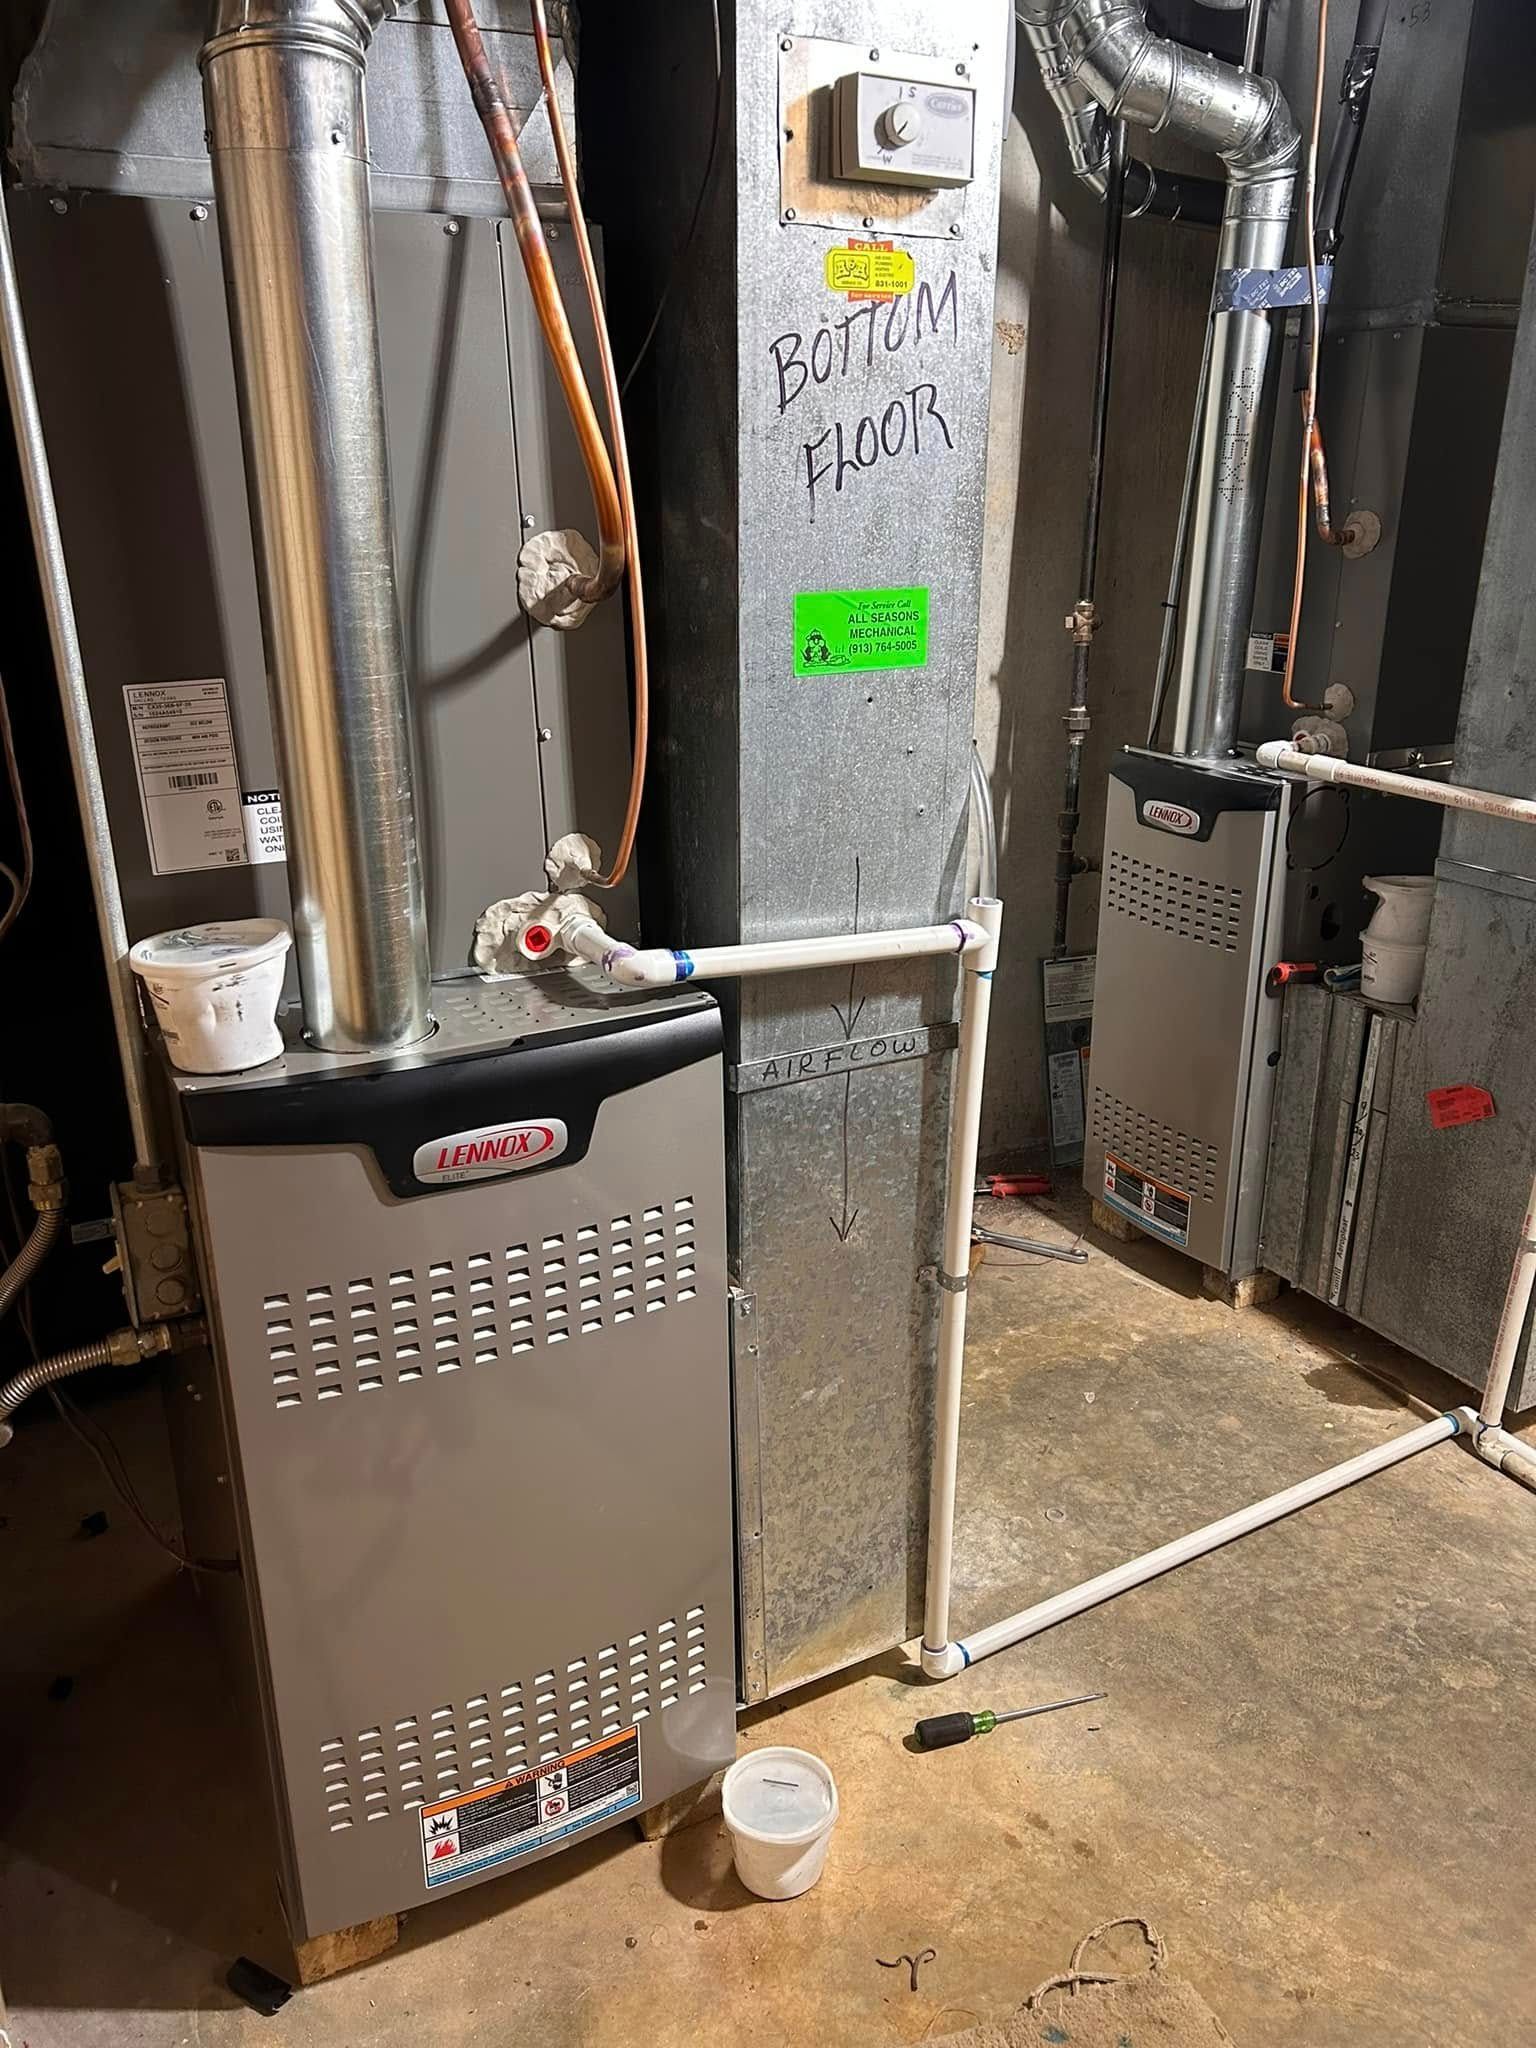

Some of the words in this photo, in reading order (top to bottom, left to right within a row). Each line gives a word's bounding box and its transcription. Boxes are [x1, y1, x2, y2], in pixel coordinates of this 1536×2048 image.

[854, 242, 888, 251] CALL
[875, 280, 908, 288] 831-1001
[769, 270, 958, 415] BOTTOM
[803, 383, 954, 524] FLOOR
[871, 601, 896, 609] Service
[896, 600, 912, 609] Call
[848, 613, 869, 624] ALL
[871, 610, 920, 623] SEASONS
[850, 625, 917, 639] MECHANICAL
[849, 643, 873, 655] (913)
[875, 640, 917, 652] 764-5005
[133, 690, 166, 698] LENNOX
[1150, 805, 1183, 824] LENNOX
[762, 1037, 916, 1081] AIRFLOW
[437, 1132, 531, 1170] LENNOX
[515, 1760, 566, 1785] WARNING
